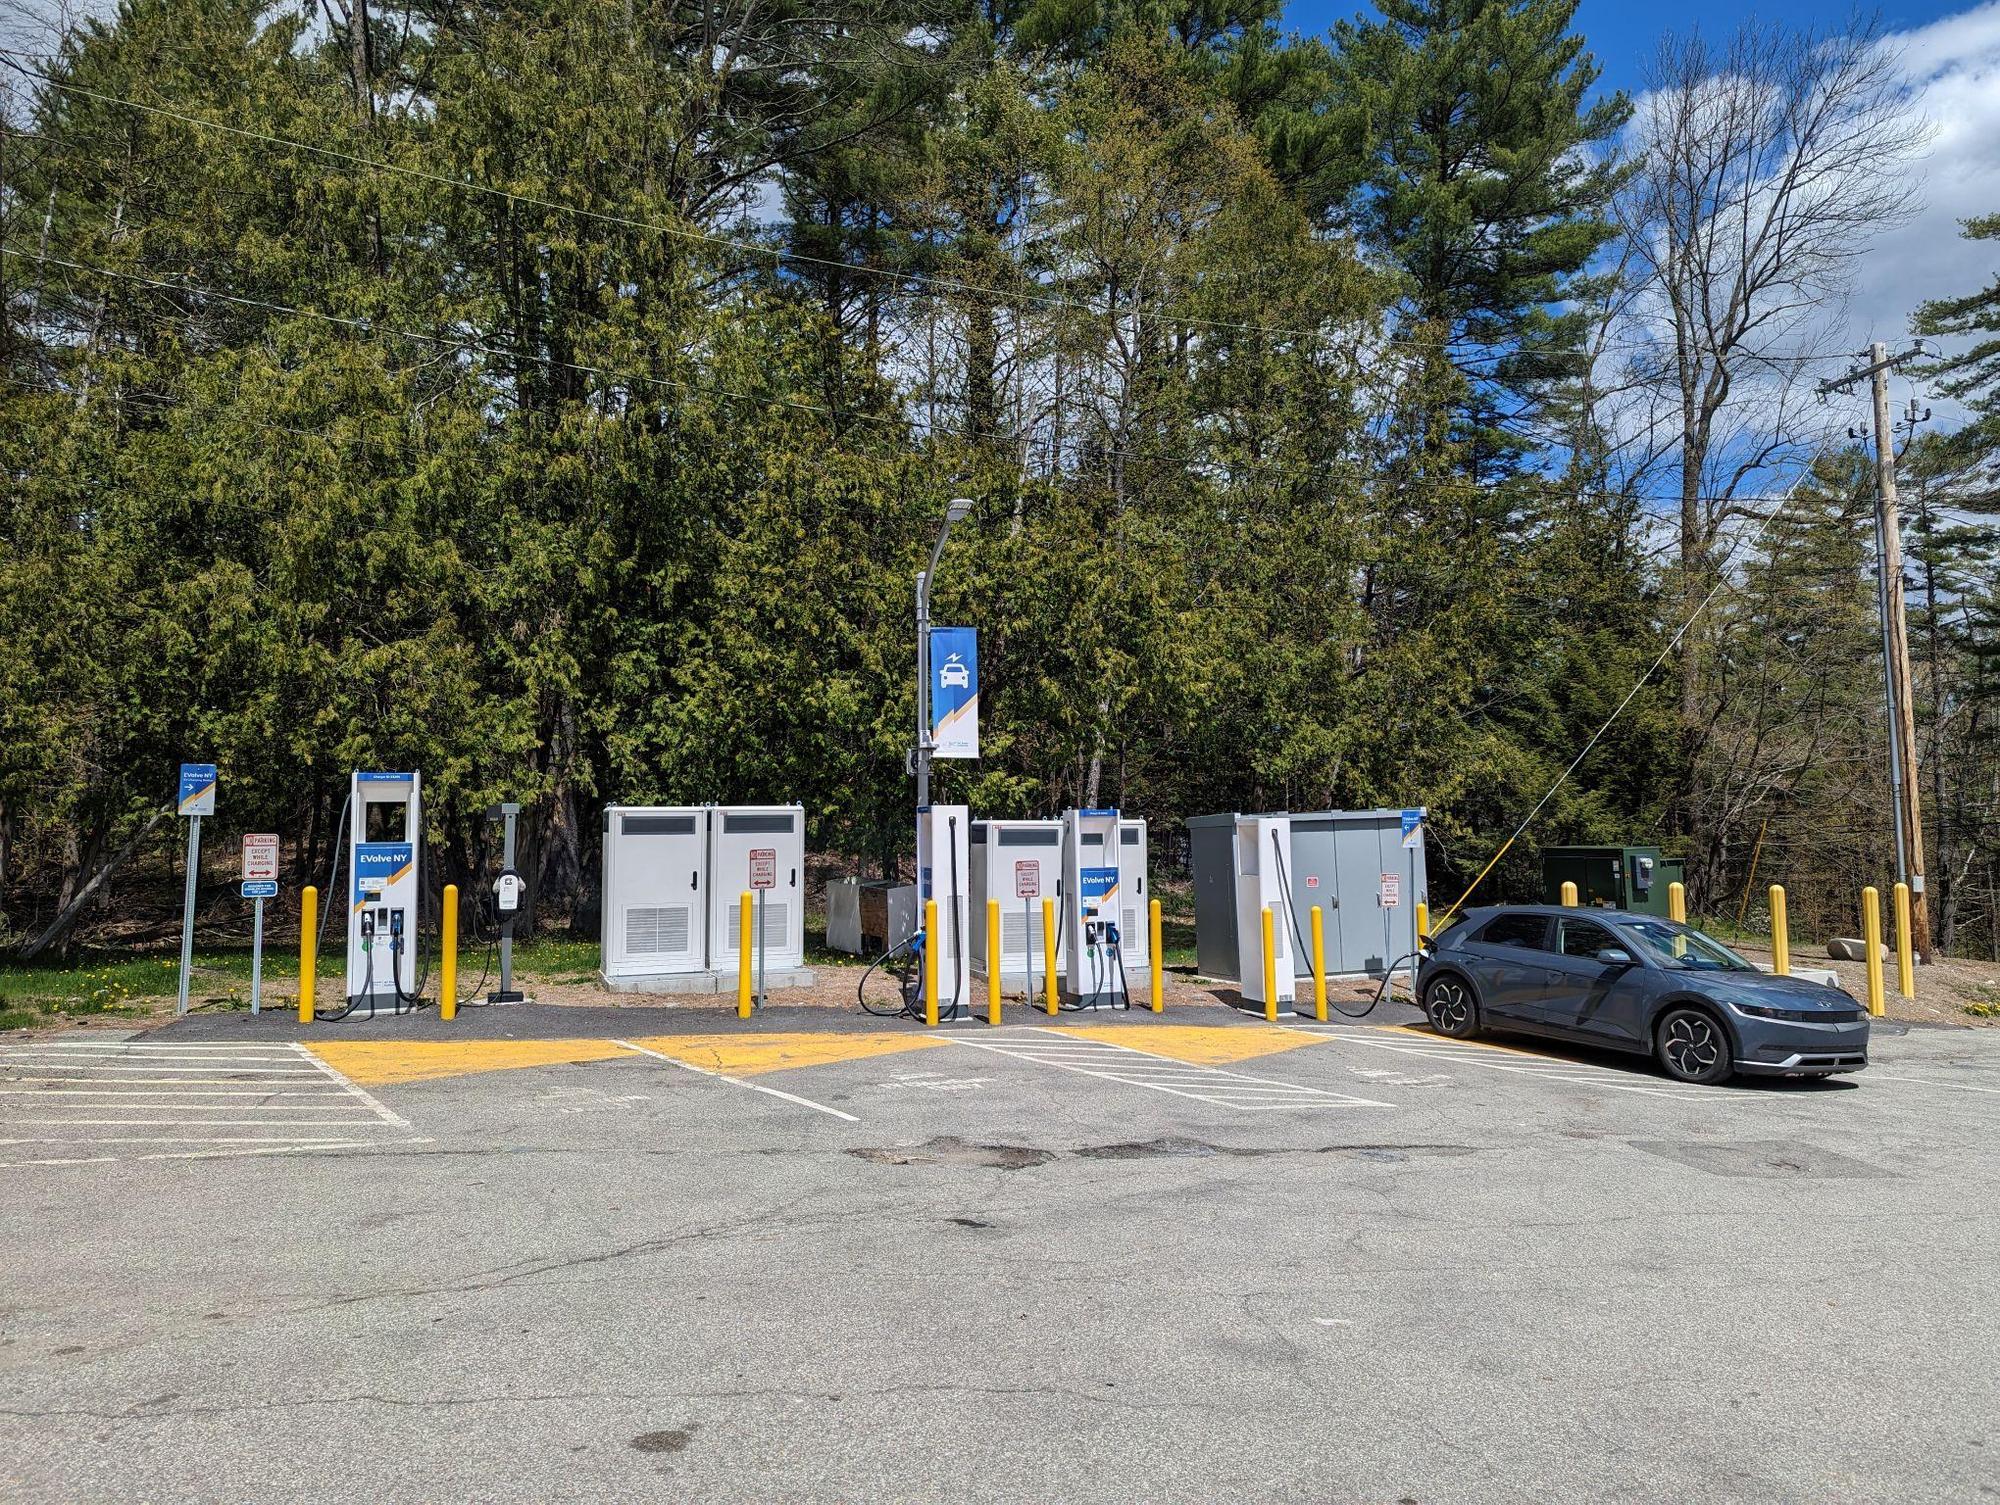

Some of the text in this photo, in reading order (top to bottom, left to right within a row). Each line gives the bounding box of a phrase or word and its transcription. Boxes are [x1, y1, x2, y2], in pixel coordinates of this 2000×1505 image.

[254, 836, 276, 844] PARKING
[360, 854, 408, 863] EVolve NY
[1082, 876, 1105, 885] EVolve
